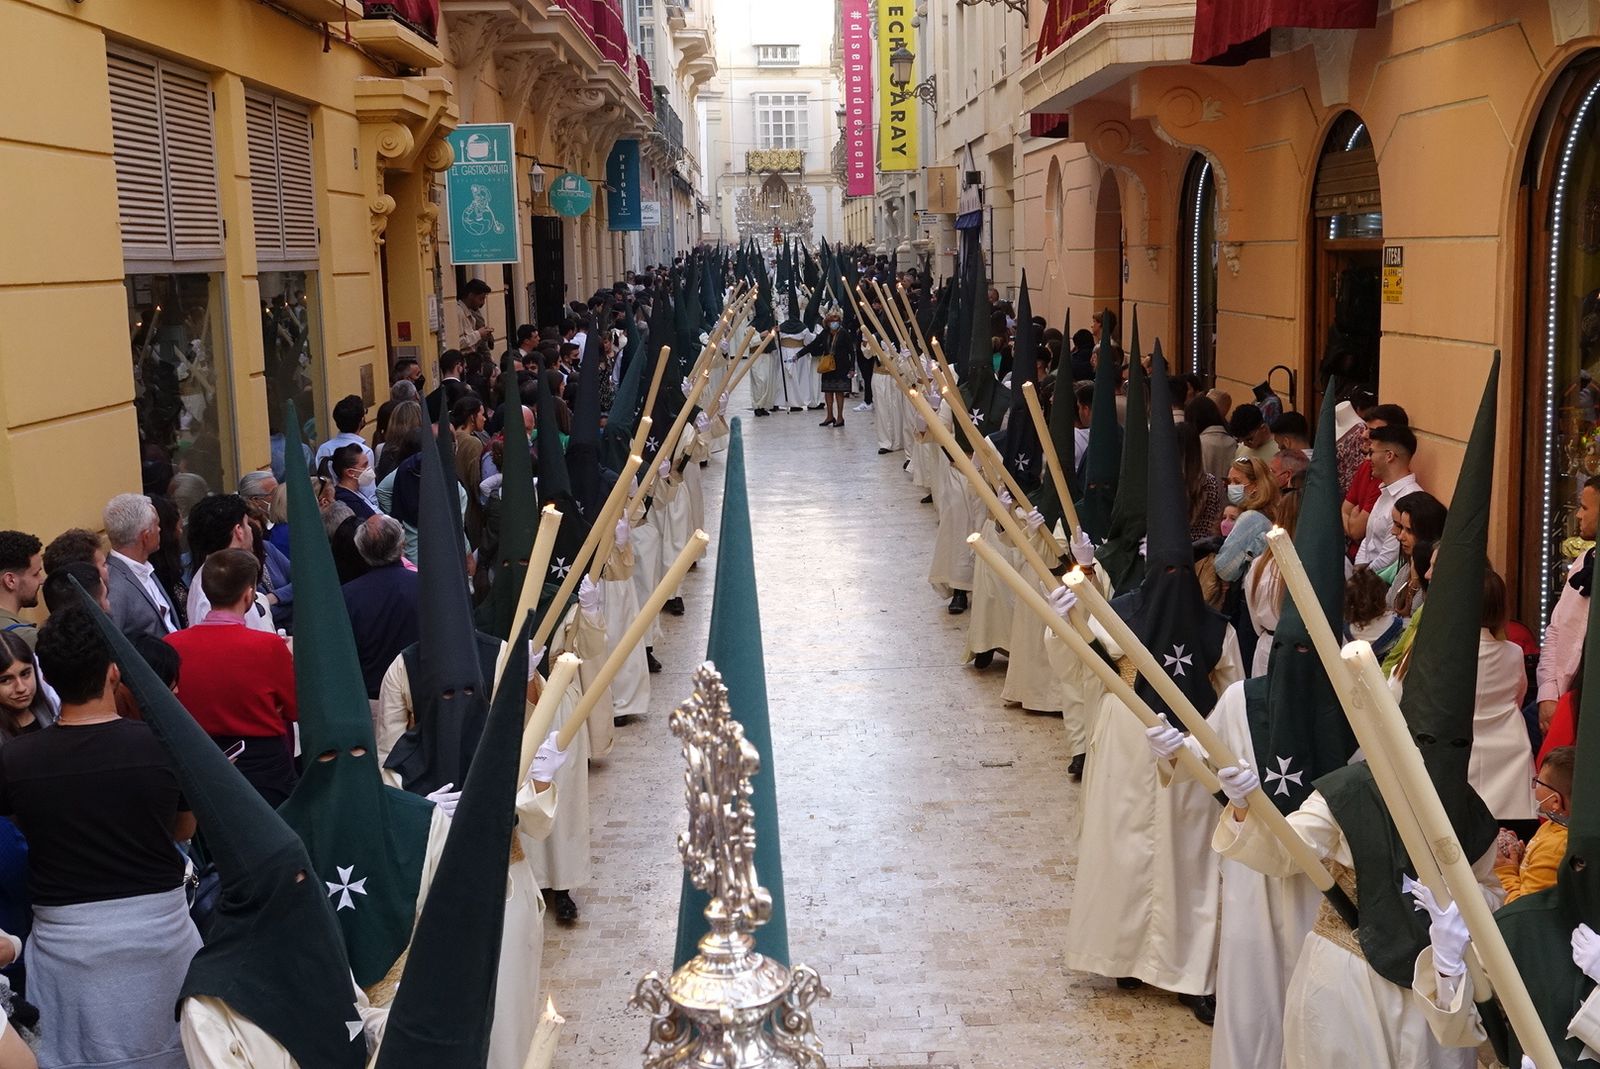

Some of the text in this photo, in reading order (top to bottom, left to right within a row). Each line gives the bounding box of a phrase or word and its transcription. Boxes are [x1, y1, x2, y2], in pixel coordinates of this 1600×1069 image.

[451, 164, 509, 176] EL GASTRONAUTA
[1385, 247, 1401, 265] ITESA
